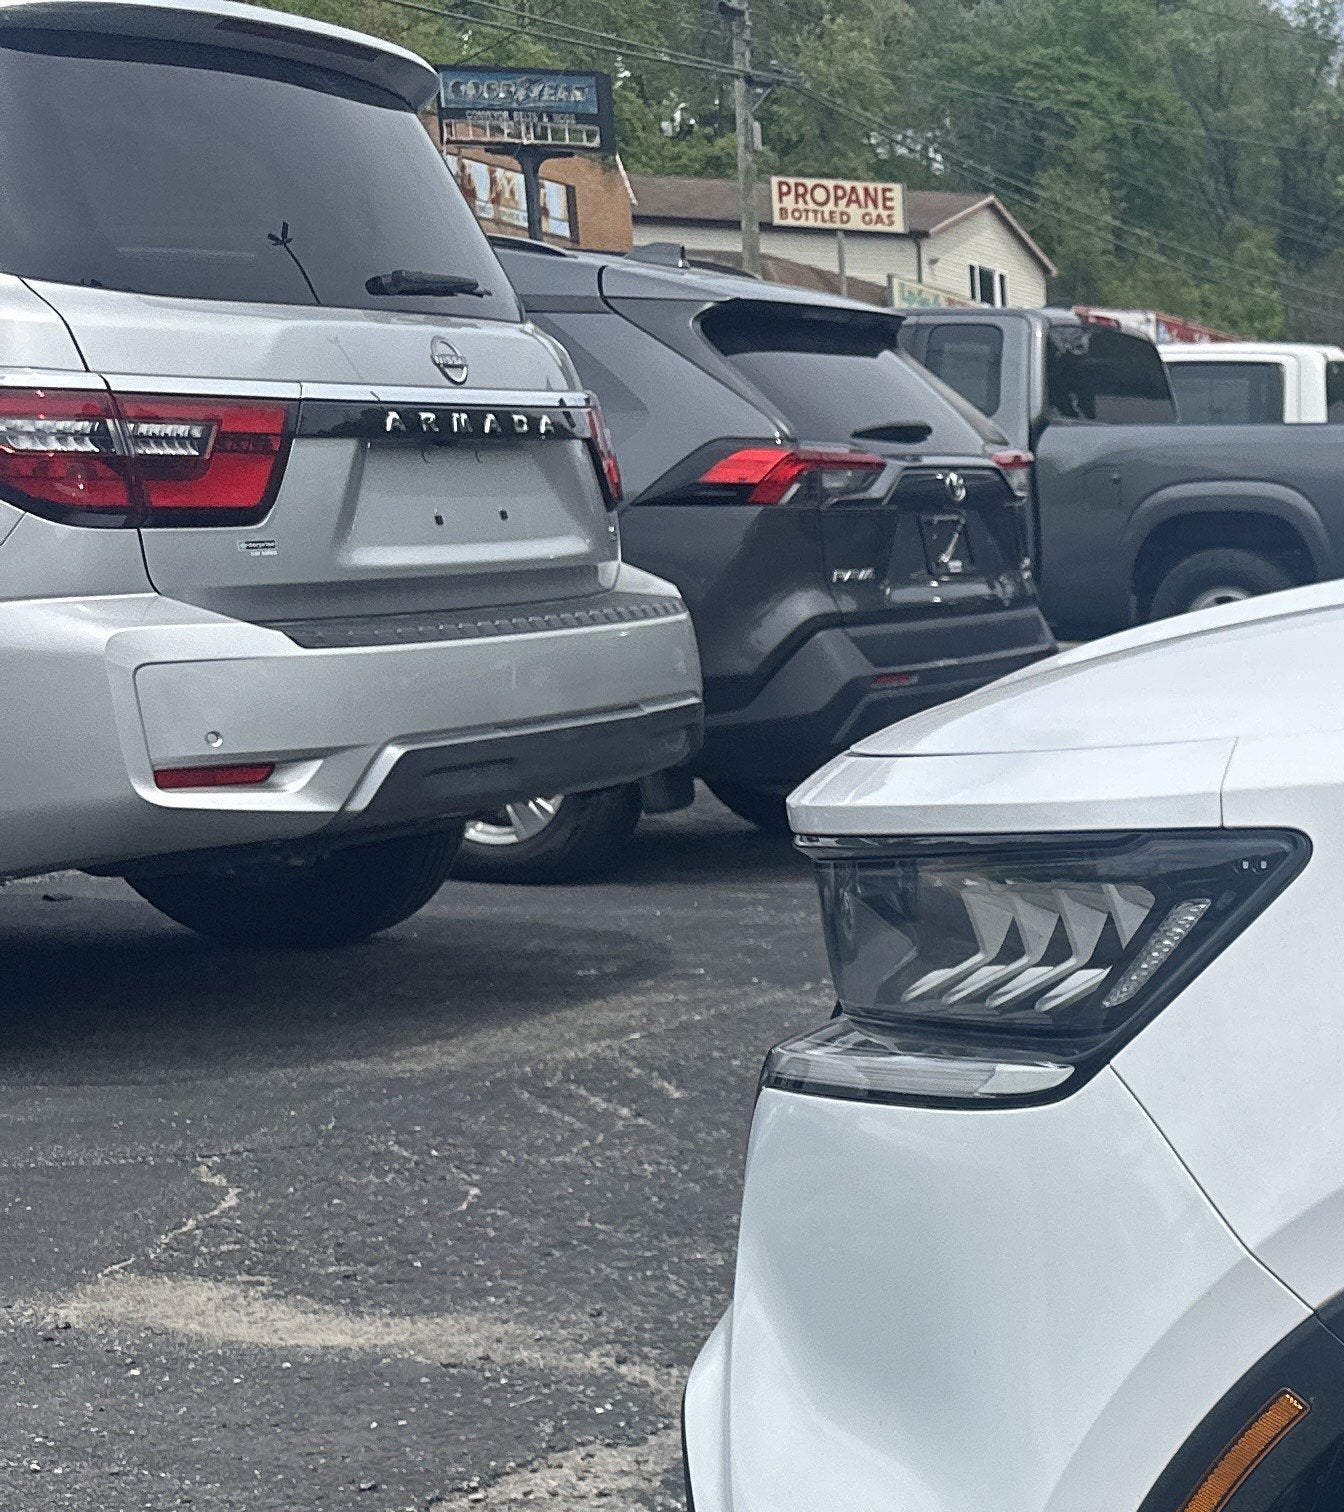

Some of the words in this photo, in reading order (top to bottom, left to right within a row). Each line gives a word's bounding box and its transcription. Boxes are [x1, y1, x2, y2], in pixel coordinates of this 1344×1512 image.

[777, 180, 895, 211] PROPANE
[779, 207, 851, 225] BOTTLED
[862, 212, 896, 227] GAS
[385, 411, 556, 434] ARMADA
